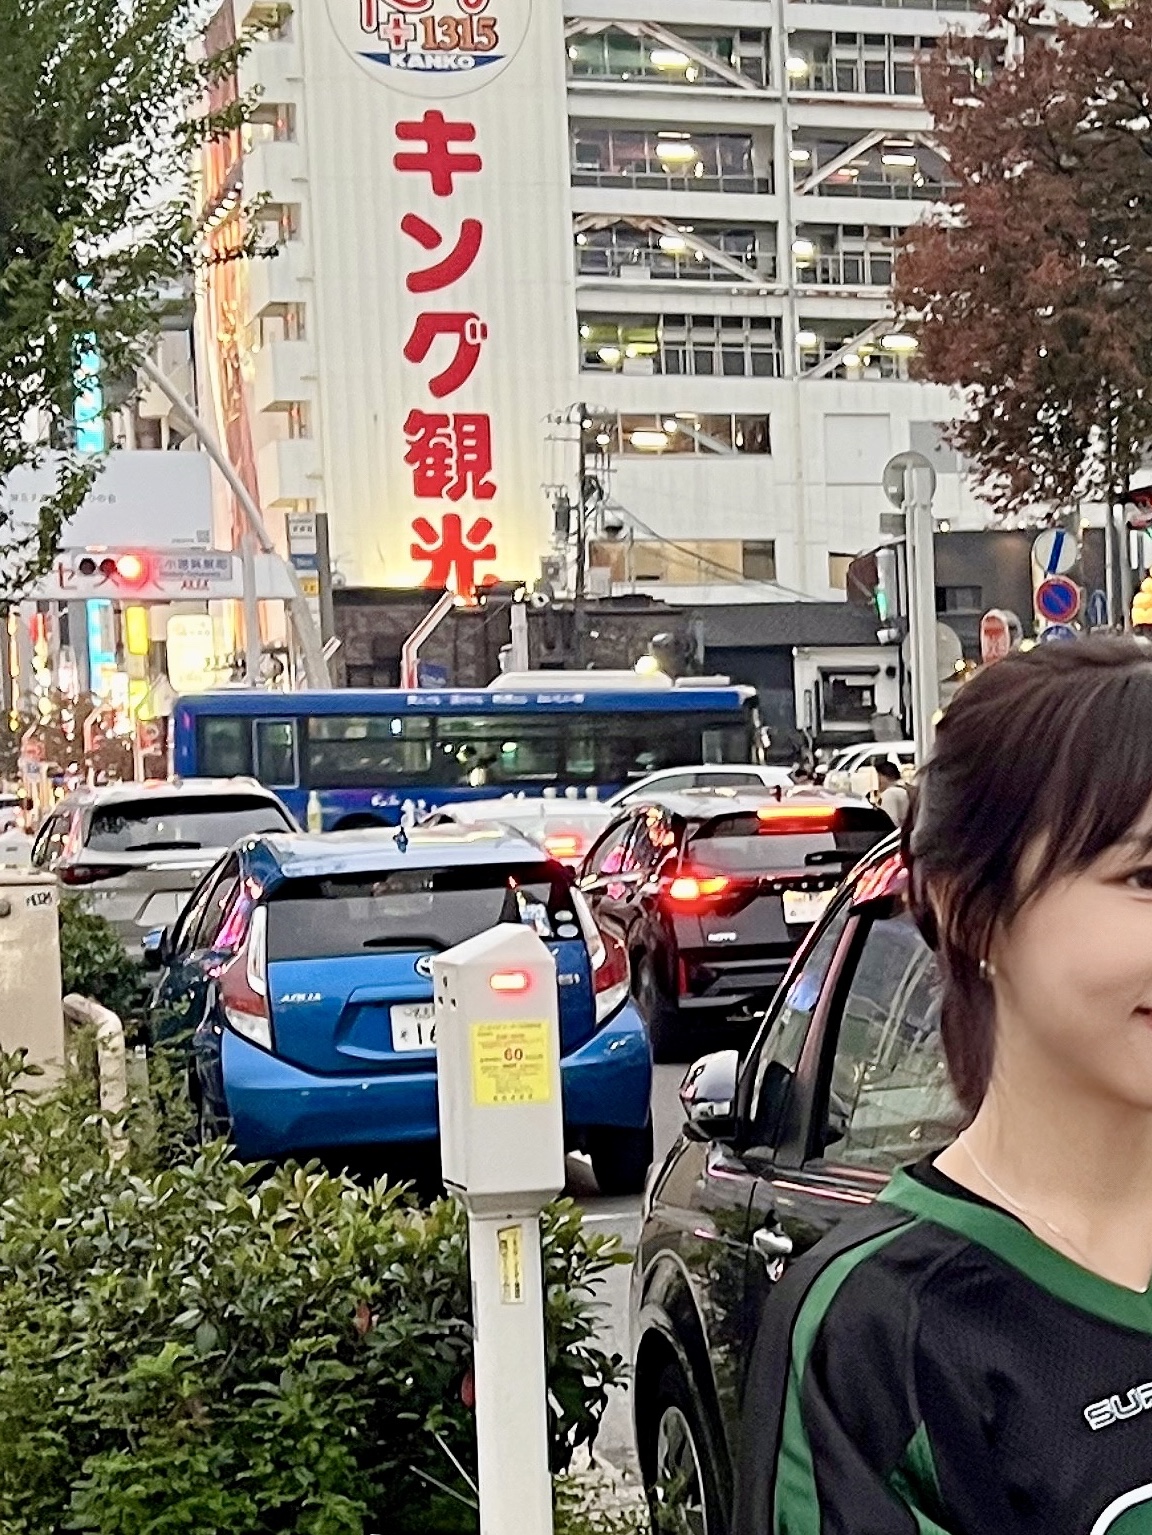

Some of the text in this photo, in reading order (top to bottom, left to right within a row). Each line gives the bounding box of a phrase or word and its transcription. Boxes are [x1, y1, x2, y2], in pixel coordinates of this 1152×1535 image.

[388, 52, 477, 70] KANKO
[394, 110, 497, 606] キング観光
[503, 1047, 524, 1062] 60
